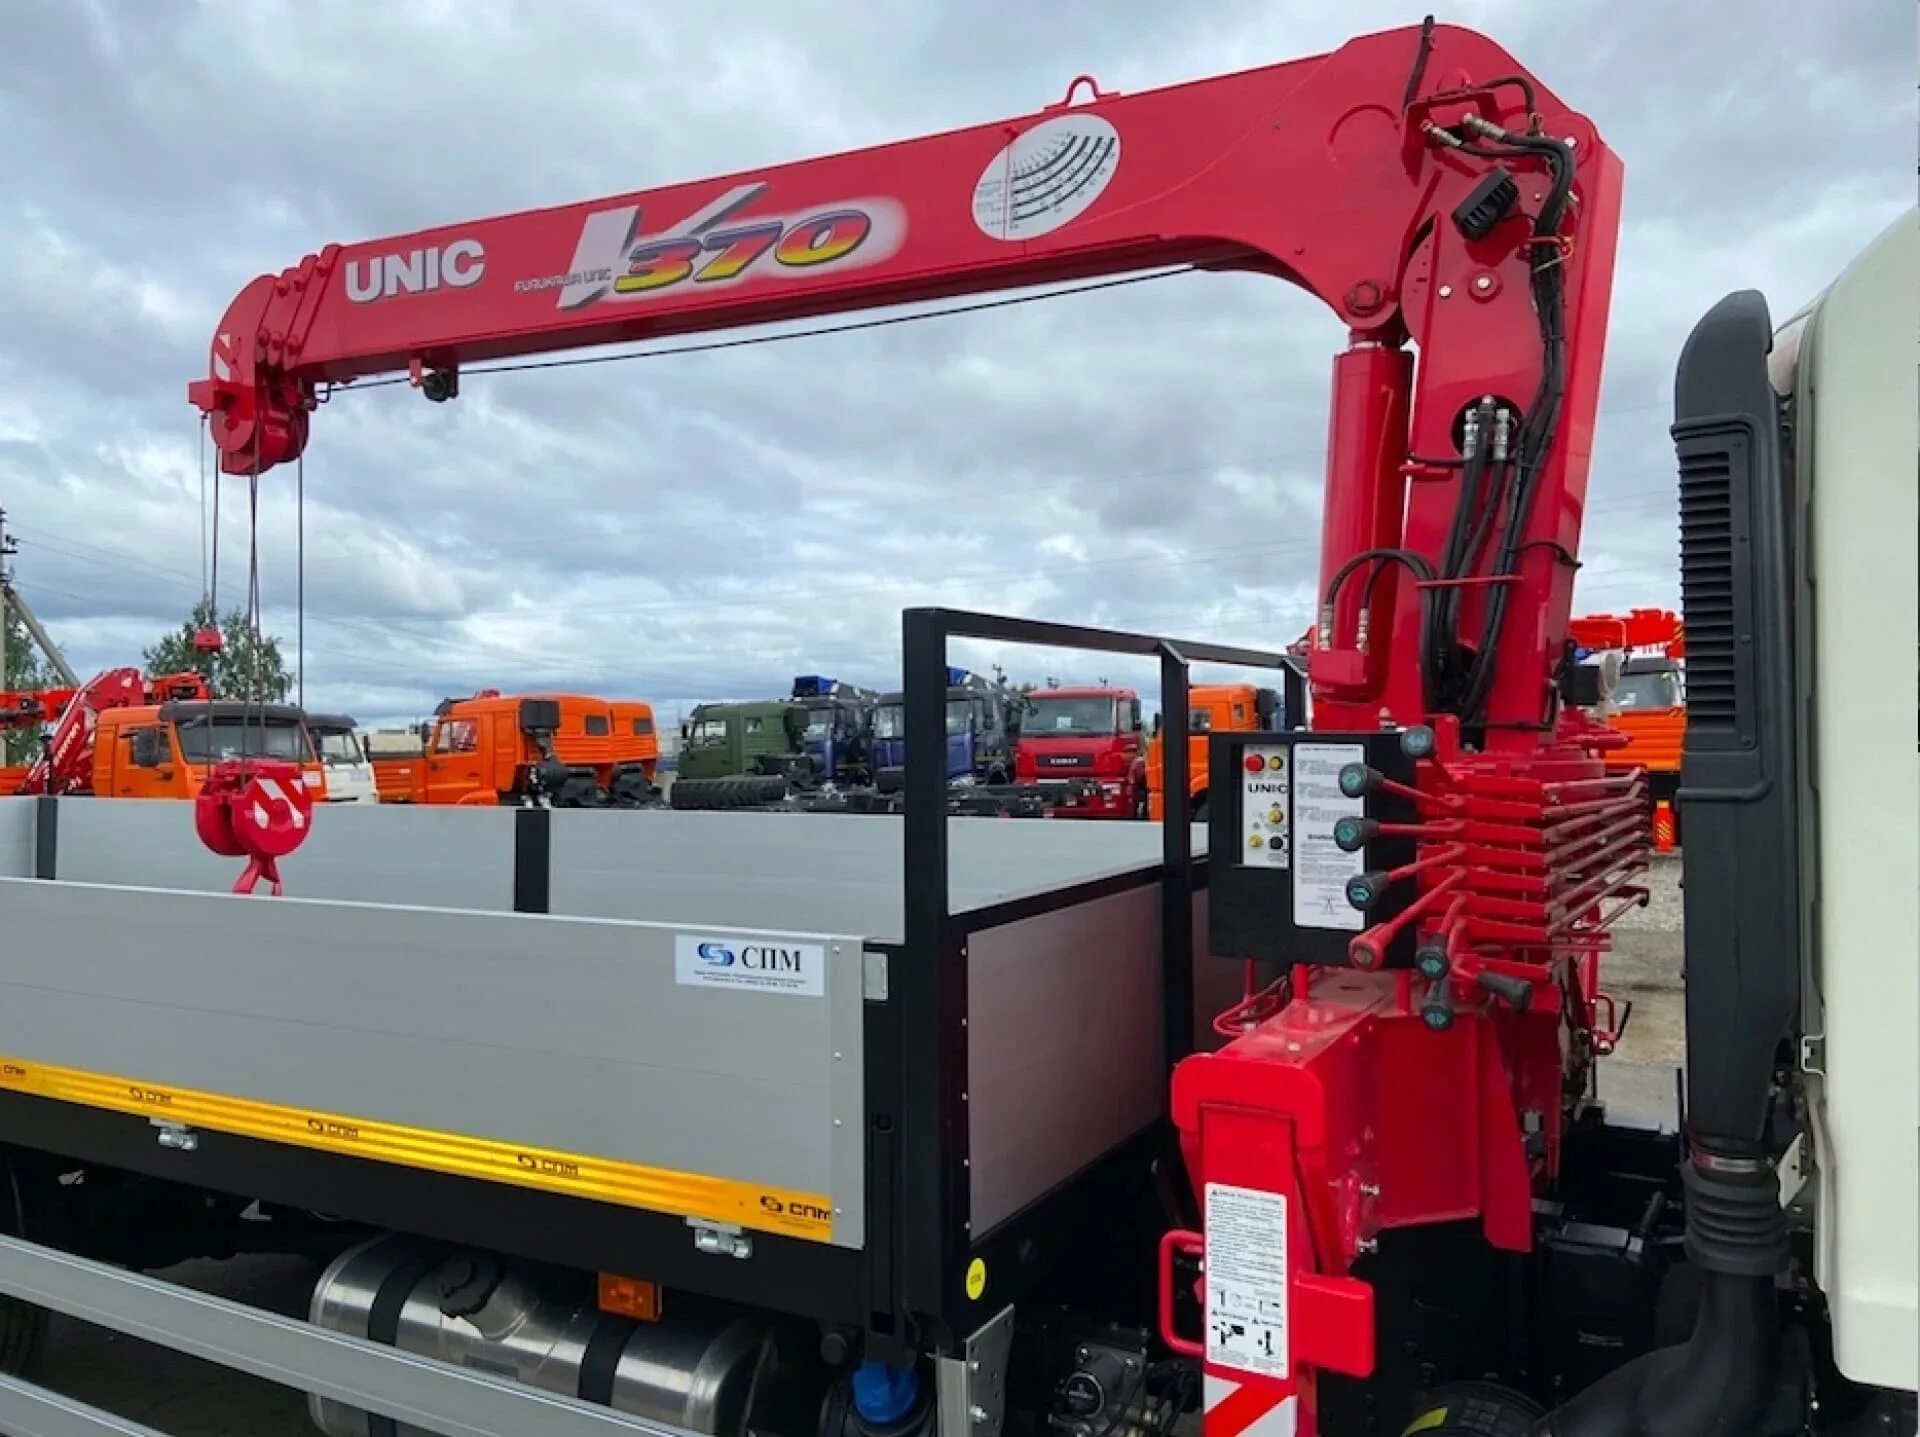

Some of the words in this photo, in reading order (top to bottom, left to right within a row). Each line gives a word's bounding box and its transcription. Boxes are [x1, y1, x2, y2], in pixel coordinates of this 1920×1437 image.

[345, 239, 485, 304] UNIC
[615, 209, 871, 294] 370
[1247, 783, 1288, 794] UNIC
[741, 946, 801, 972] СПМ
